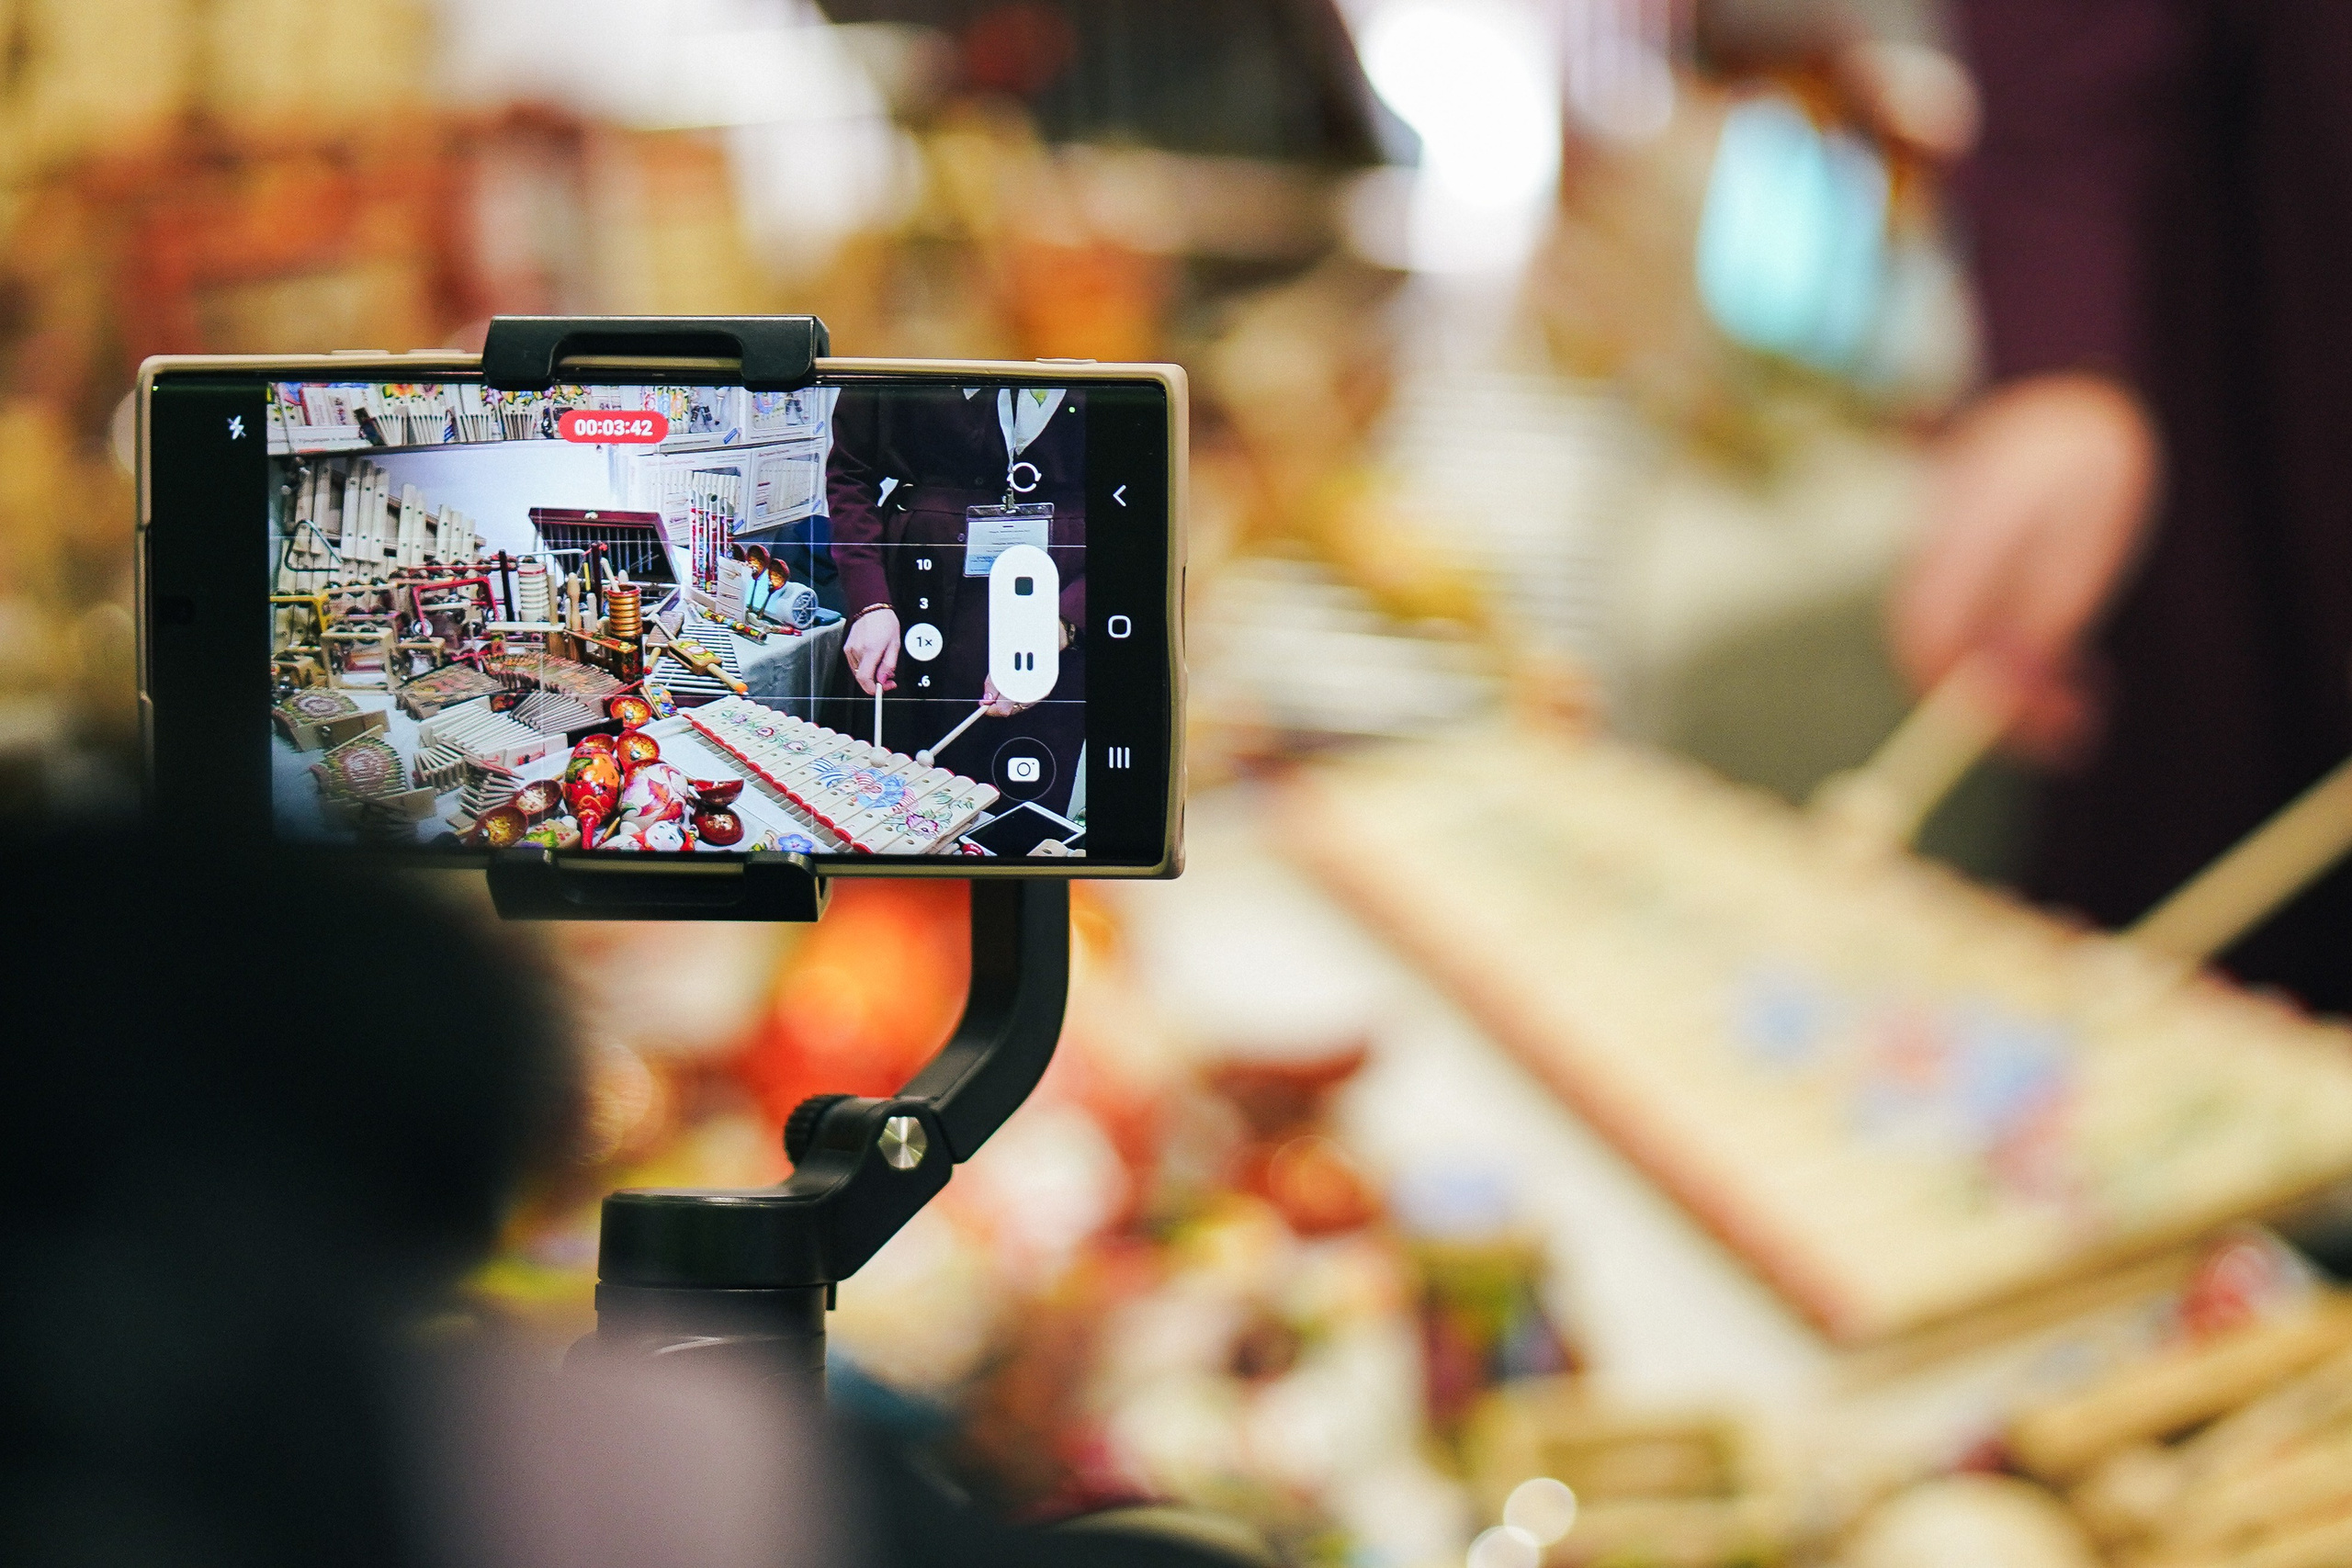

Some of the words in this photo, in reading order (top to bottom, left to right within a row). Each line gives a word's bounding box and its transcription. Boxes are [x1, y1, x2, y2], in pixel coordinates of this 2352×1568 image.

[574, 419, 653, 436] 00:03:42
[916, 558, 933, 570] 10
[919, 597, 929, 610] 3
[918, 675, 931, 687] .6
